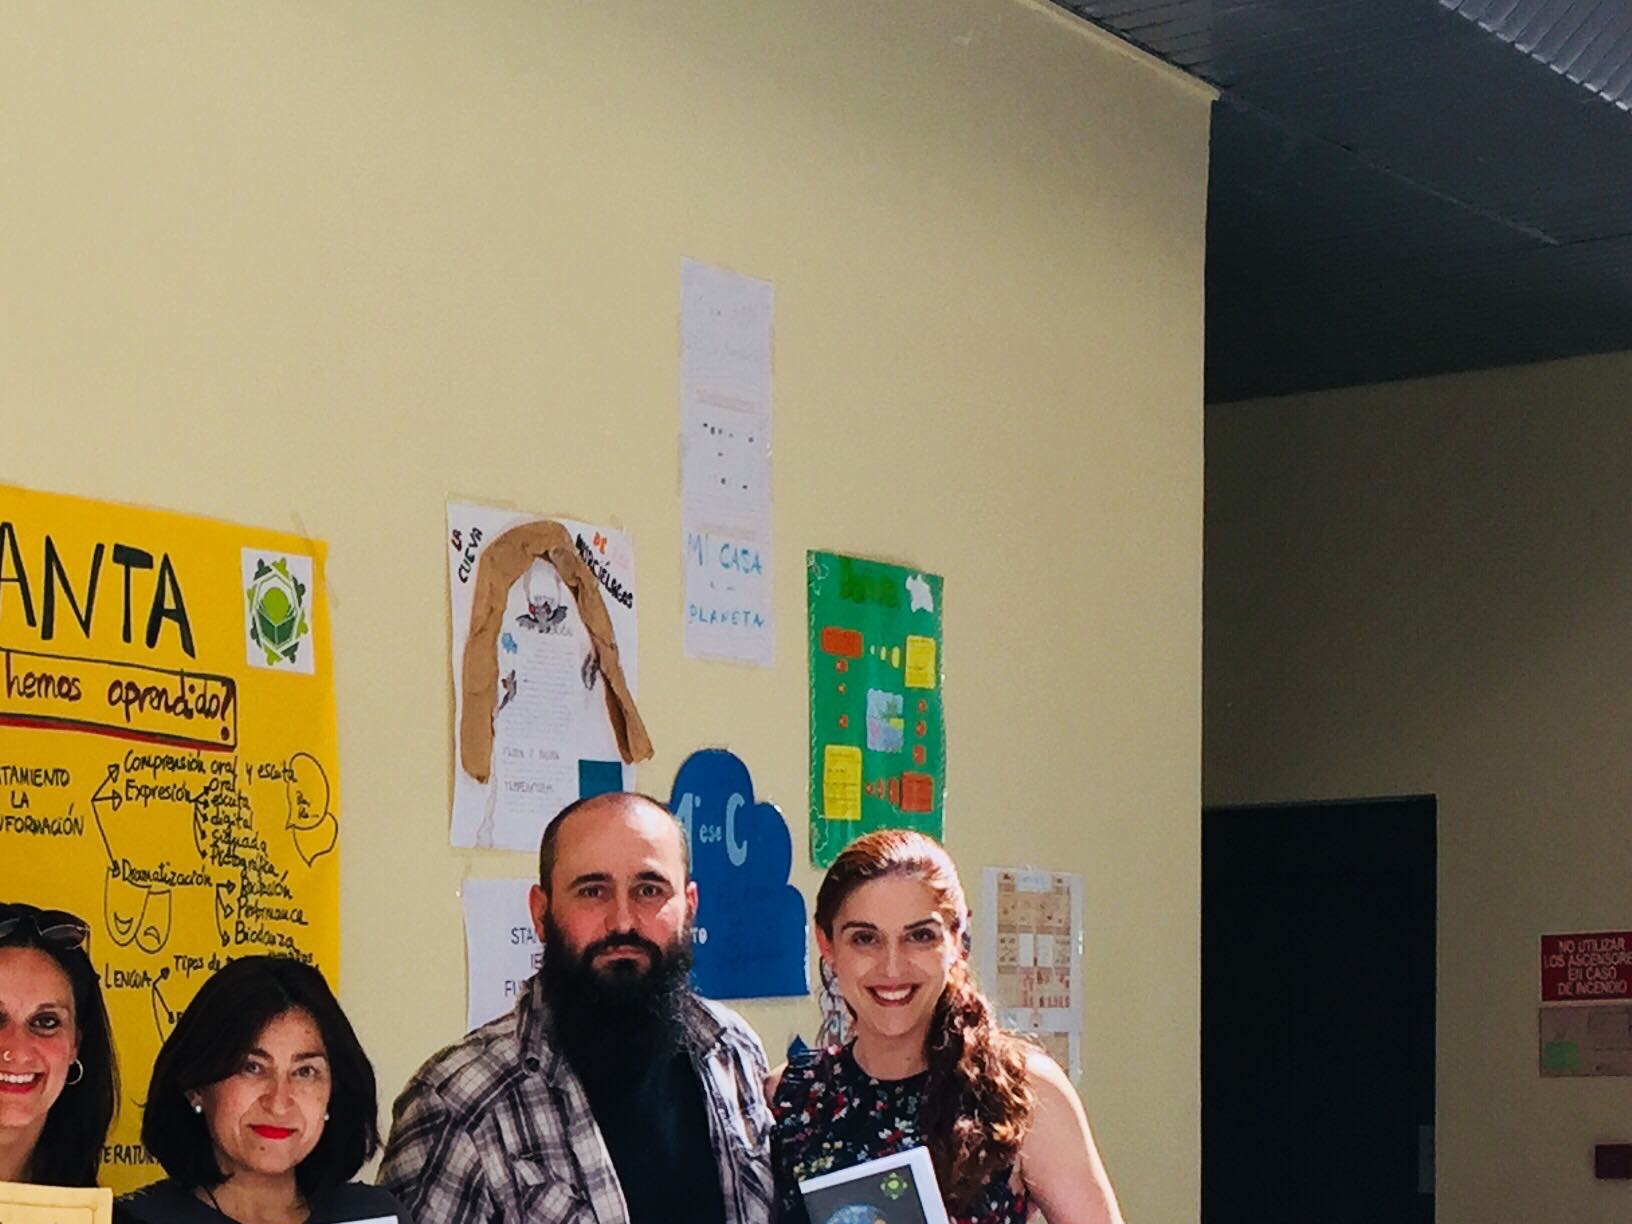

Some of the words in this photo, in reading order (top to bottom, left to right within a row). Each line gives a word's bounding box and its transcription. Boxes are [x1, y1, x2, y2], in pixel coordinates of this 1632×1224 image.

[458, 527, 484, 584] CUEVA
[719, 542, 763, 576] CASA
[5, 648, 84, 703] hemos
[107, 675, 235, 741] aprendido?
[211, 756, 238, 780] oral
[11, 789, 30, 809] LA
[1568, 951, 1632, 966] ASCENSORE
